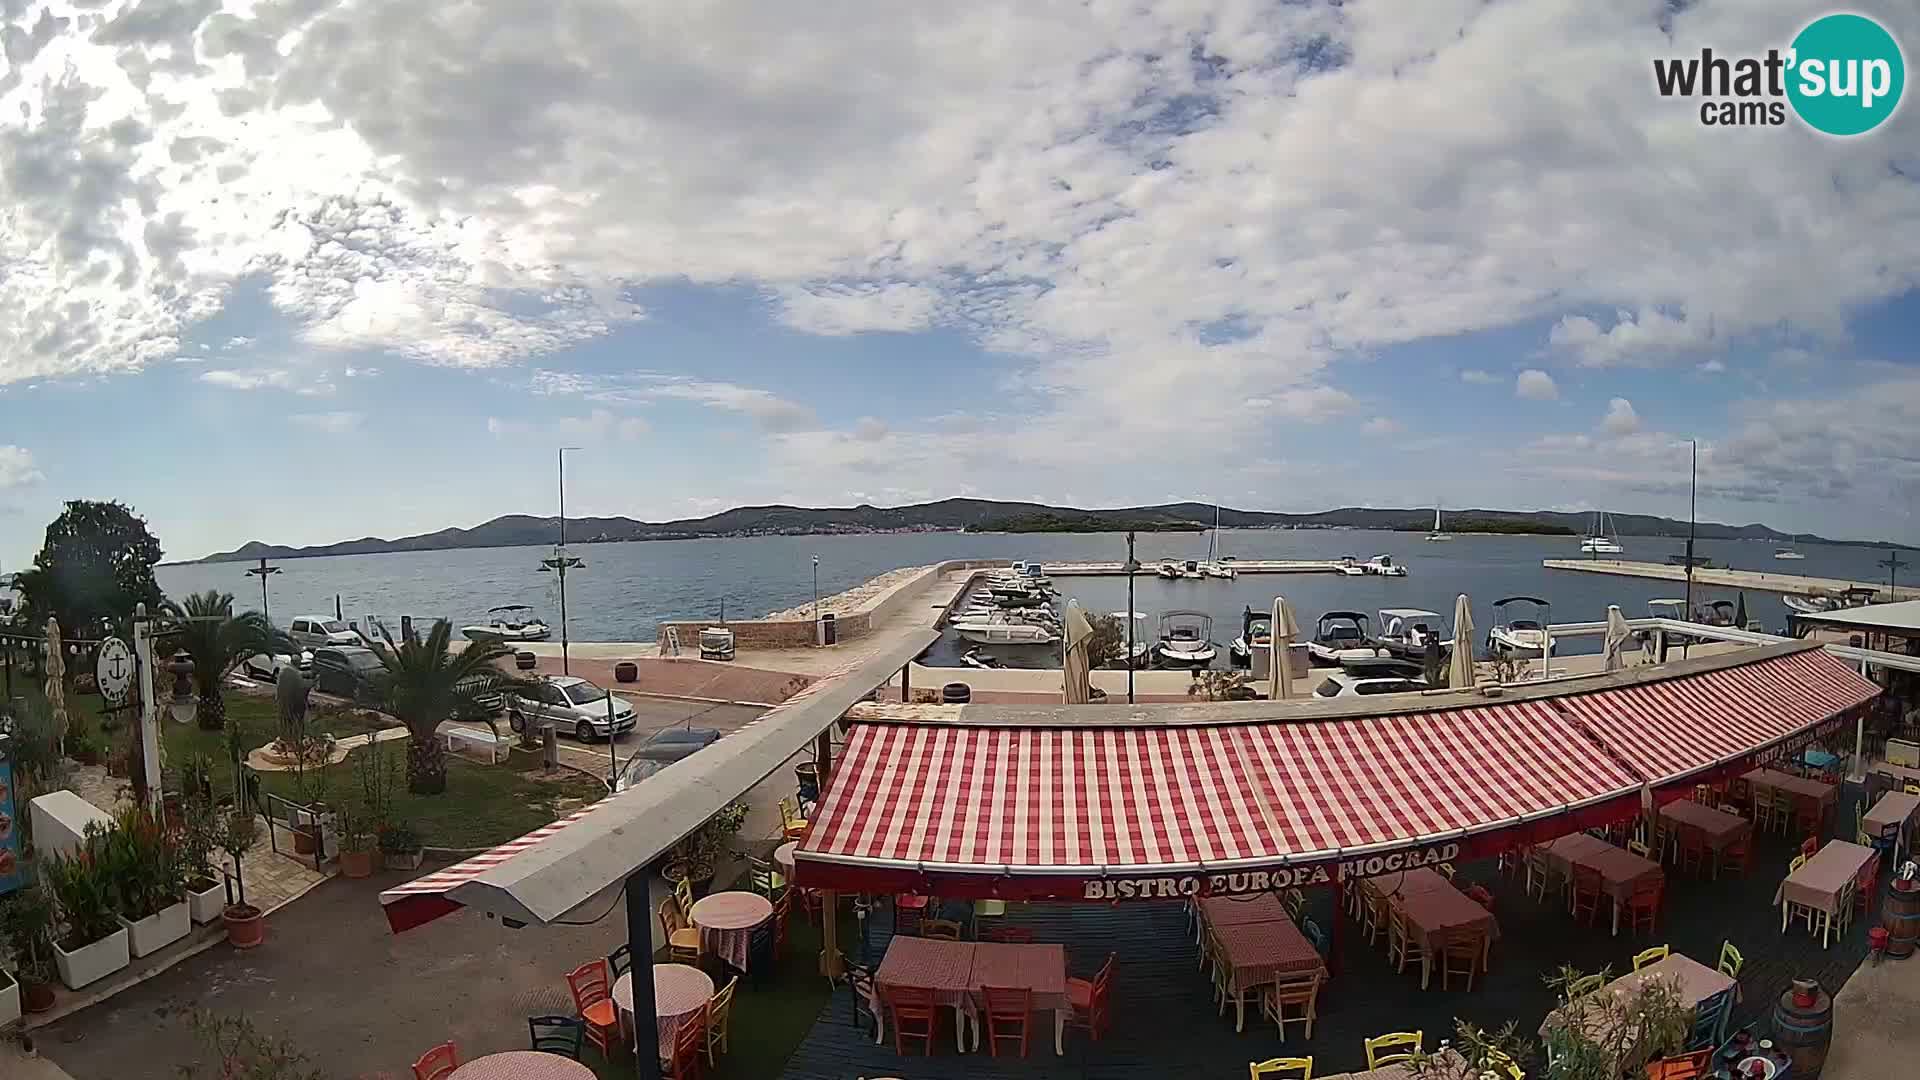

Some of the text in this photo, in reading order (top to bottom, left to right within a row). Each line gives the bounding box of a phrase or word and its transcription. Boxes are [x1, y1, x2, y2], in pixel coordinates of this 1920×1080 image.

[1084, 843, 1459, 899] BISTRO EUROPA BIOGRAD
